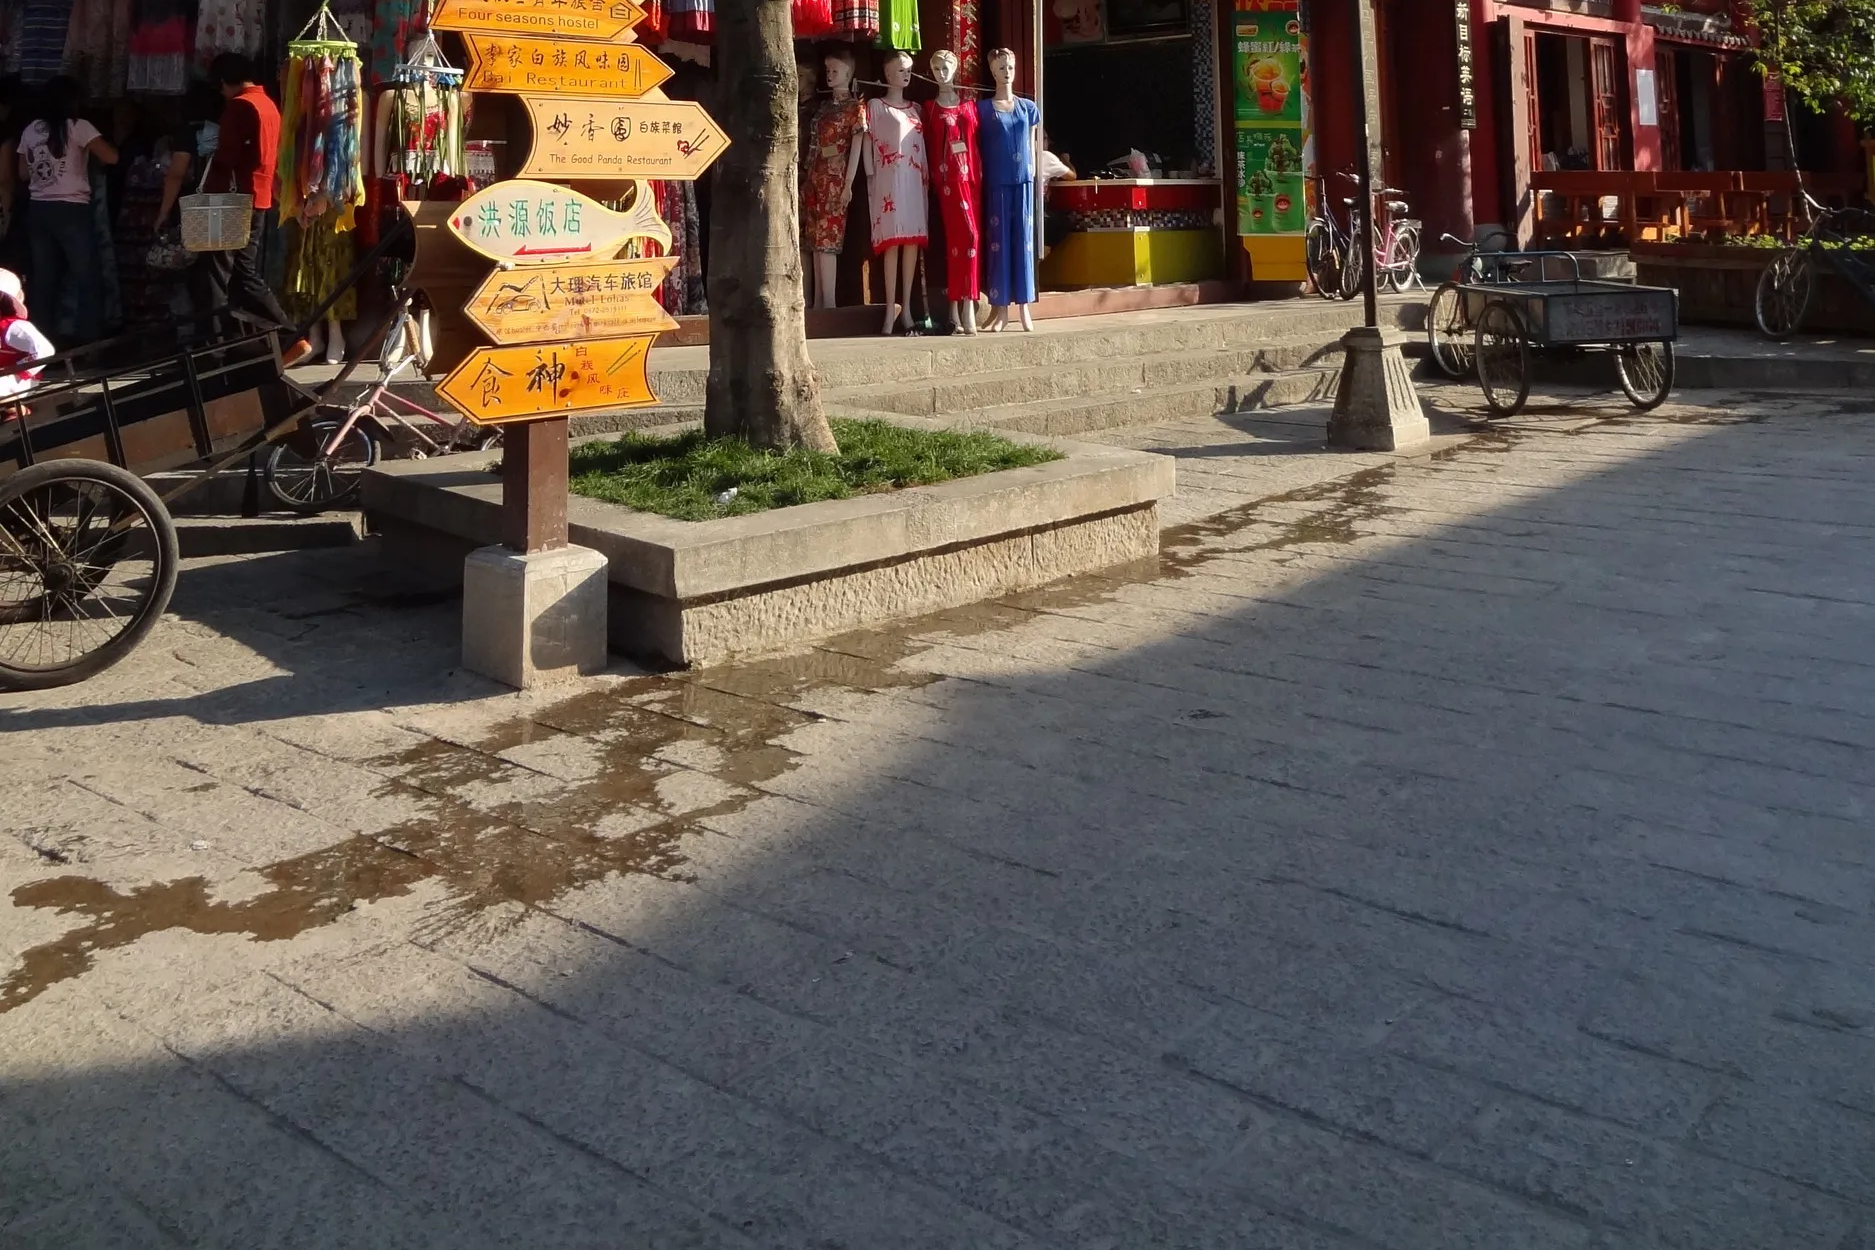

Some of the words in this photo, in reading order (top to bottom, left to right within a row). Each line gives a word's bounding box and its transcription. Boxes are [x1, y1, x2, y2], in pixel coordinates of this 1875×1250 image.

[458, 7, 492, 21] Four
[495, 12, 554, 26] seasons
[558, 16, 599, 30] hostel
[1456, 2, 1473, 106] 新目标英语
[526, 72, 628, 90] Restaurant
[550, 154, 566, 164] The
[571, 154, 593, 165] Good
[597, 154, 622, 165] Panda
[627, 155, 672, 166] Restaurant
[478, 198, 583, 238] 洪源饭店
[550, 272, 653, 296] 大理汽车旅馆
[470, 351, 566, 408] 食神
